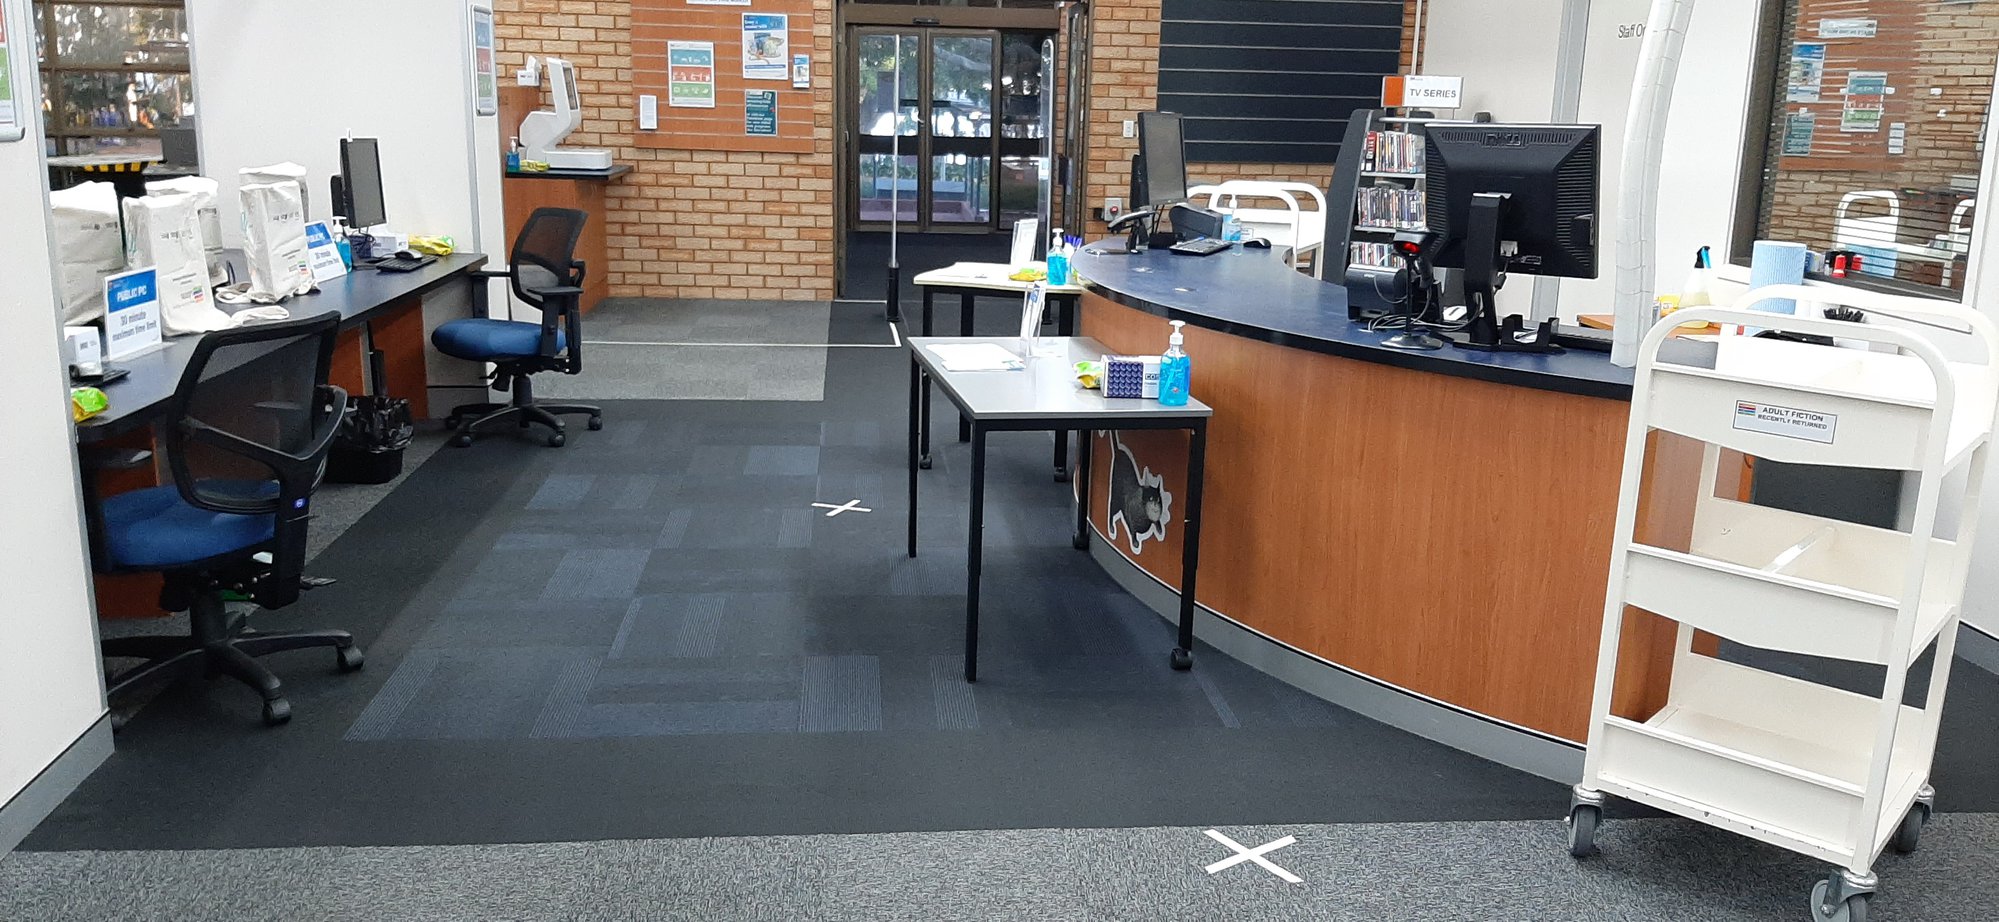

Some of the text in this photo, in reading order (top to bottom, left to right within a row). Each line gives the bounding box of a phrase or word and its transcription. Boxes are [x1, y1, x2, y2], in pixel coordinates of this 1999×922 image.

[1617, 23, 1636, 38] Staff
[1410, 88, 1457, 98] TV SERIES
[117, 284, 148, 302] PUBLIC PC
[1757, 413, 1828, 430] RECENTLY RETURNED
[1762, 406, 1824, 422] ADULT FICTION
